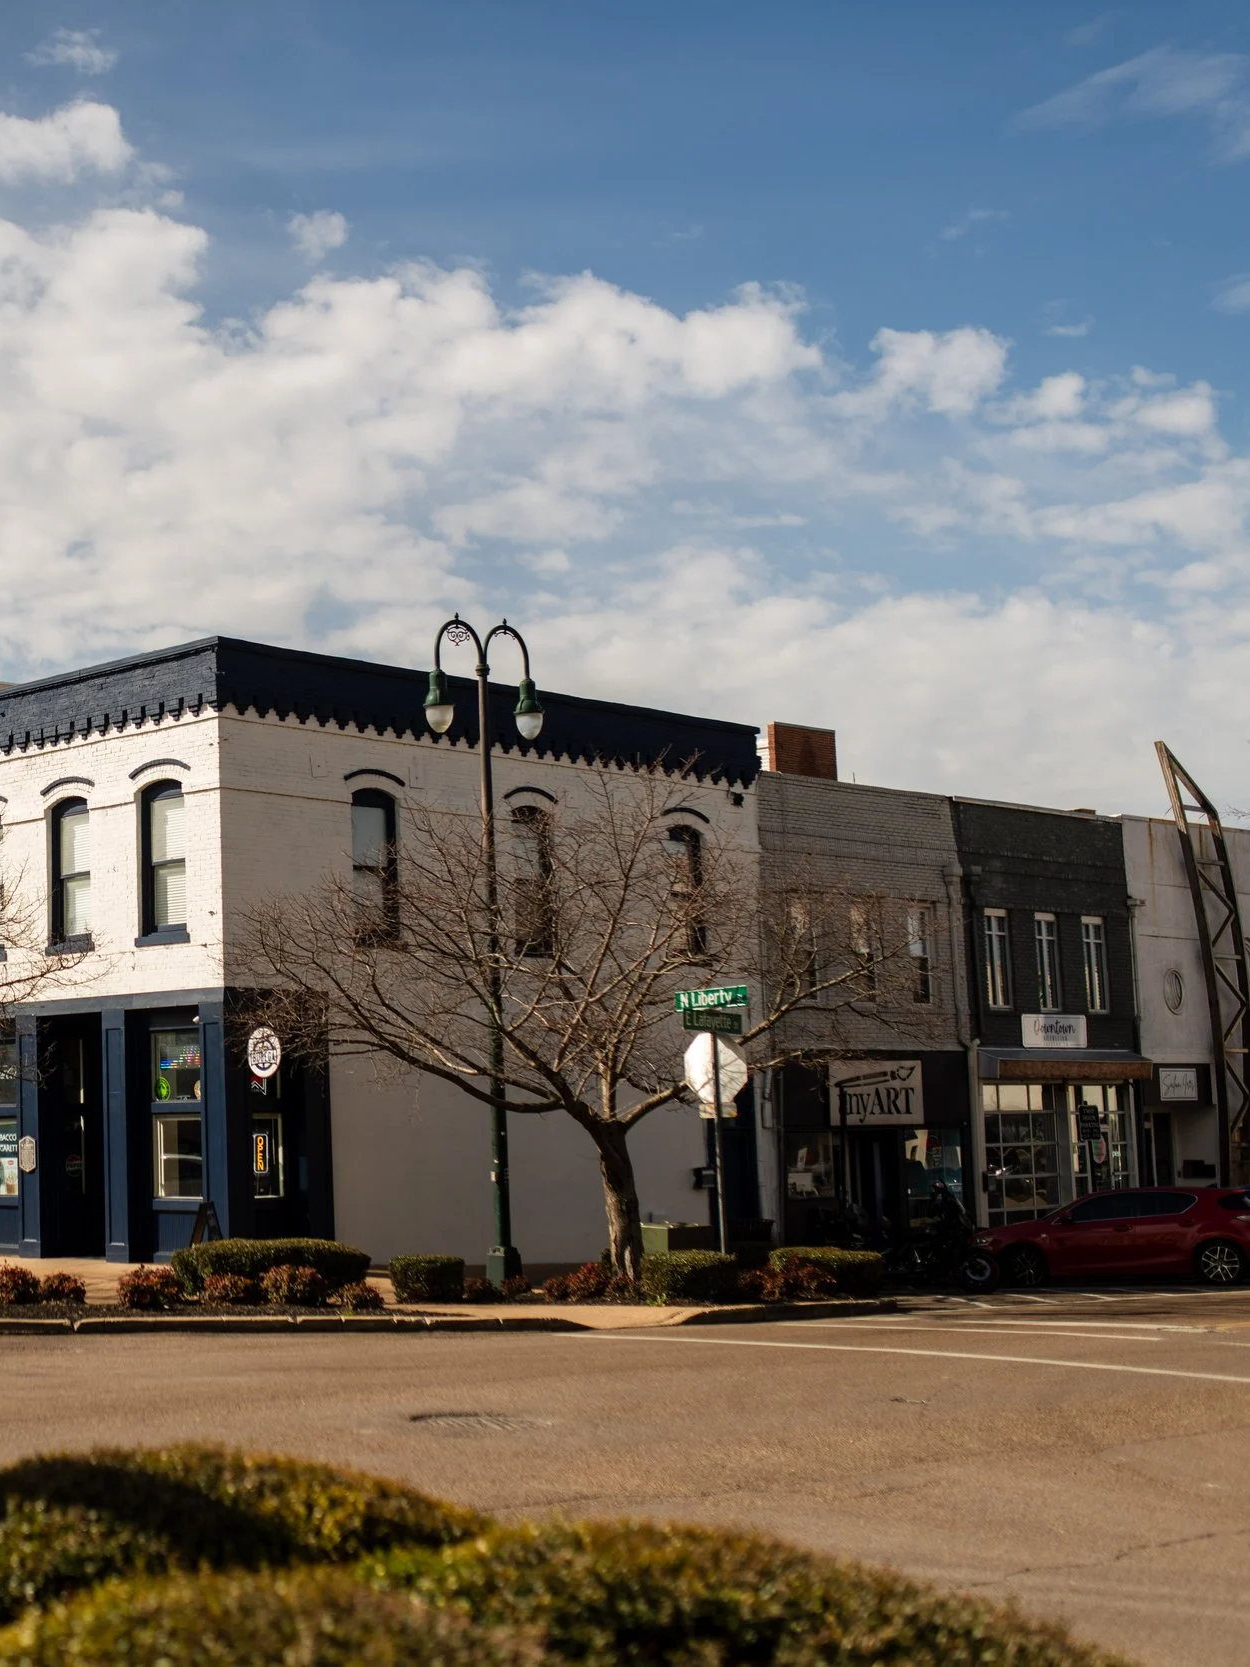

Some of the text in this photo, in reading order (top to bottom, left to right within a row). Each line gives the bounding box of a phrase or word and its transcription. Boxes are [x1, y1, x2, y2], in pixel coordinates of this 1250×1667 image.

[680, 993, 689, 1008] N
[691, 989, 732, 1006] Liberty
[686, 1012, 691, 1026] E
[693, 1012, 732, 1029] Lafayette
[1033, 1019, 1076, 1036] Downtown
